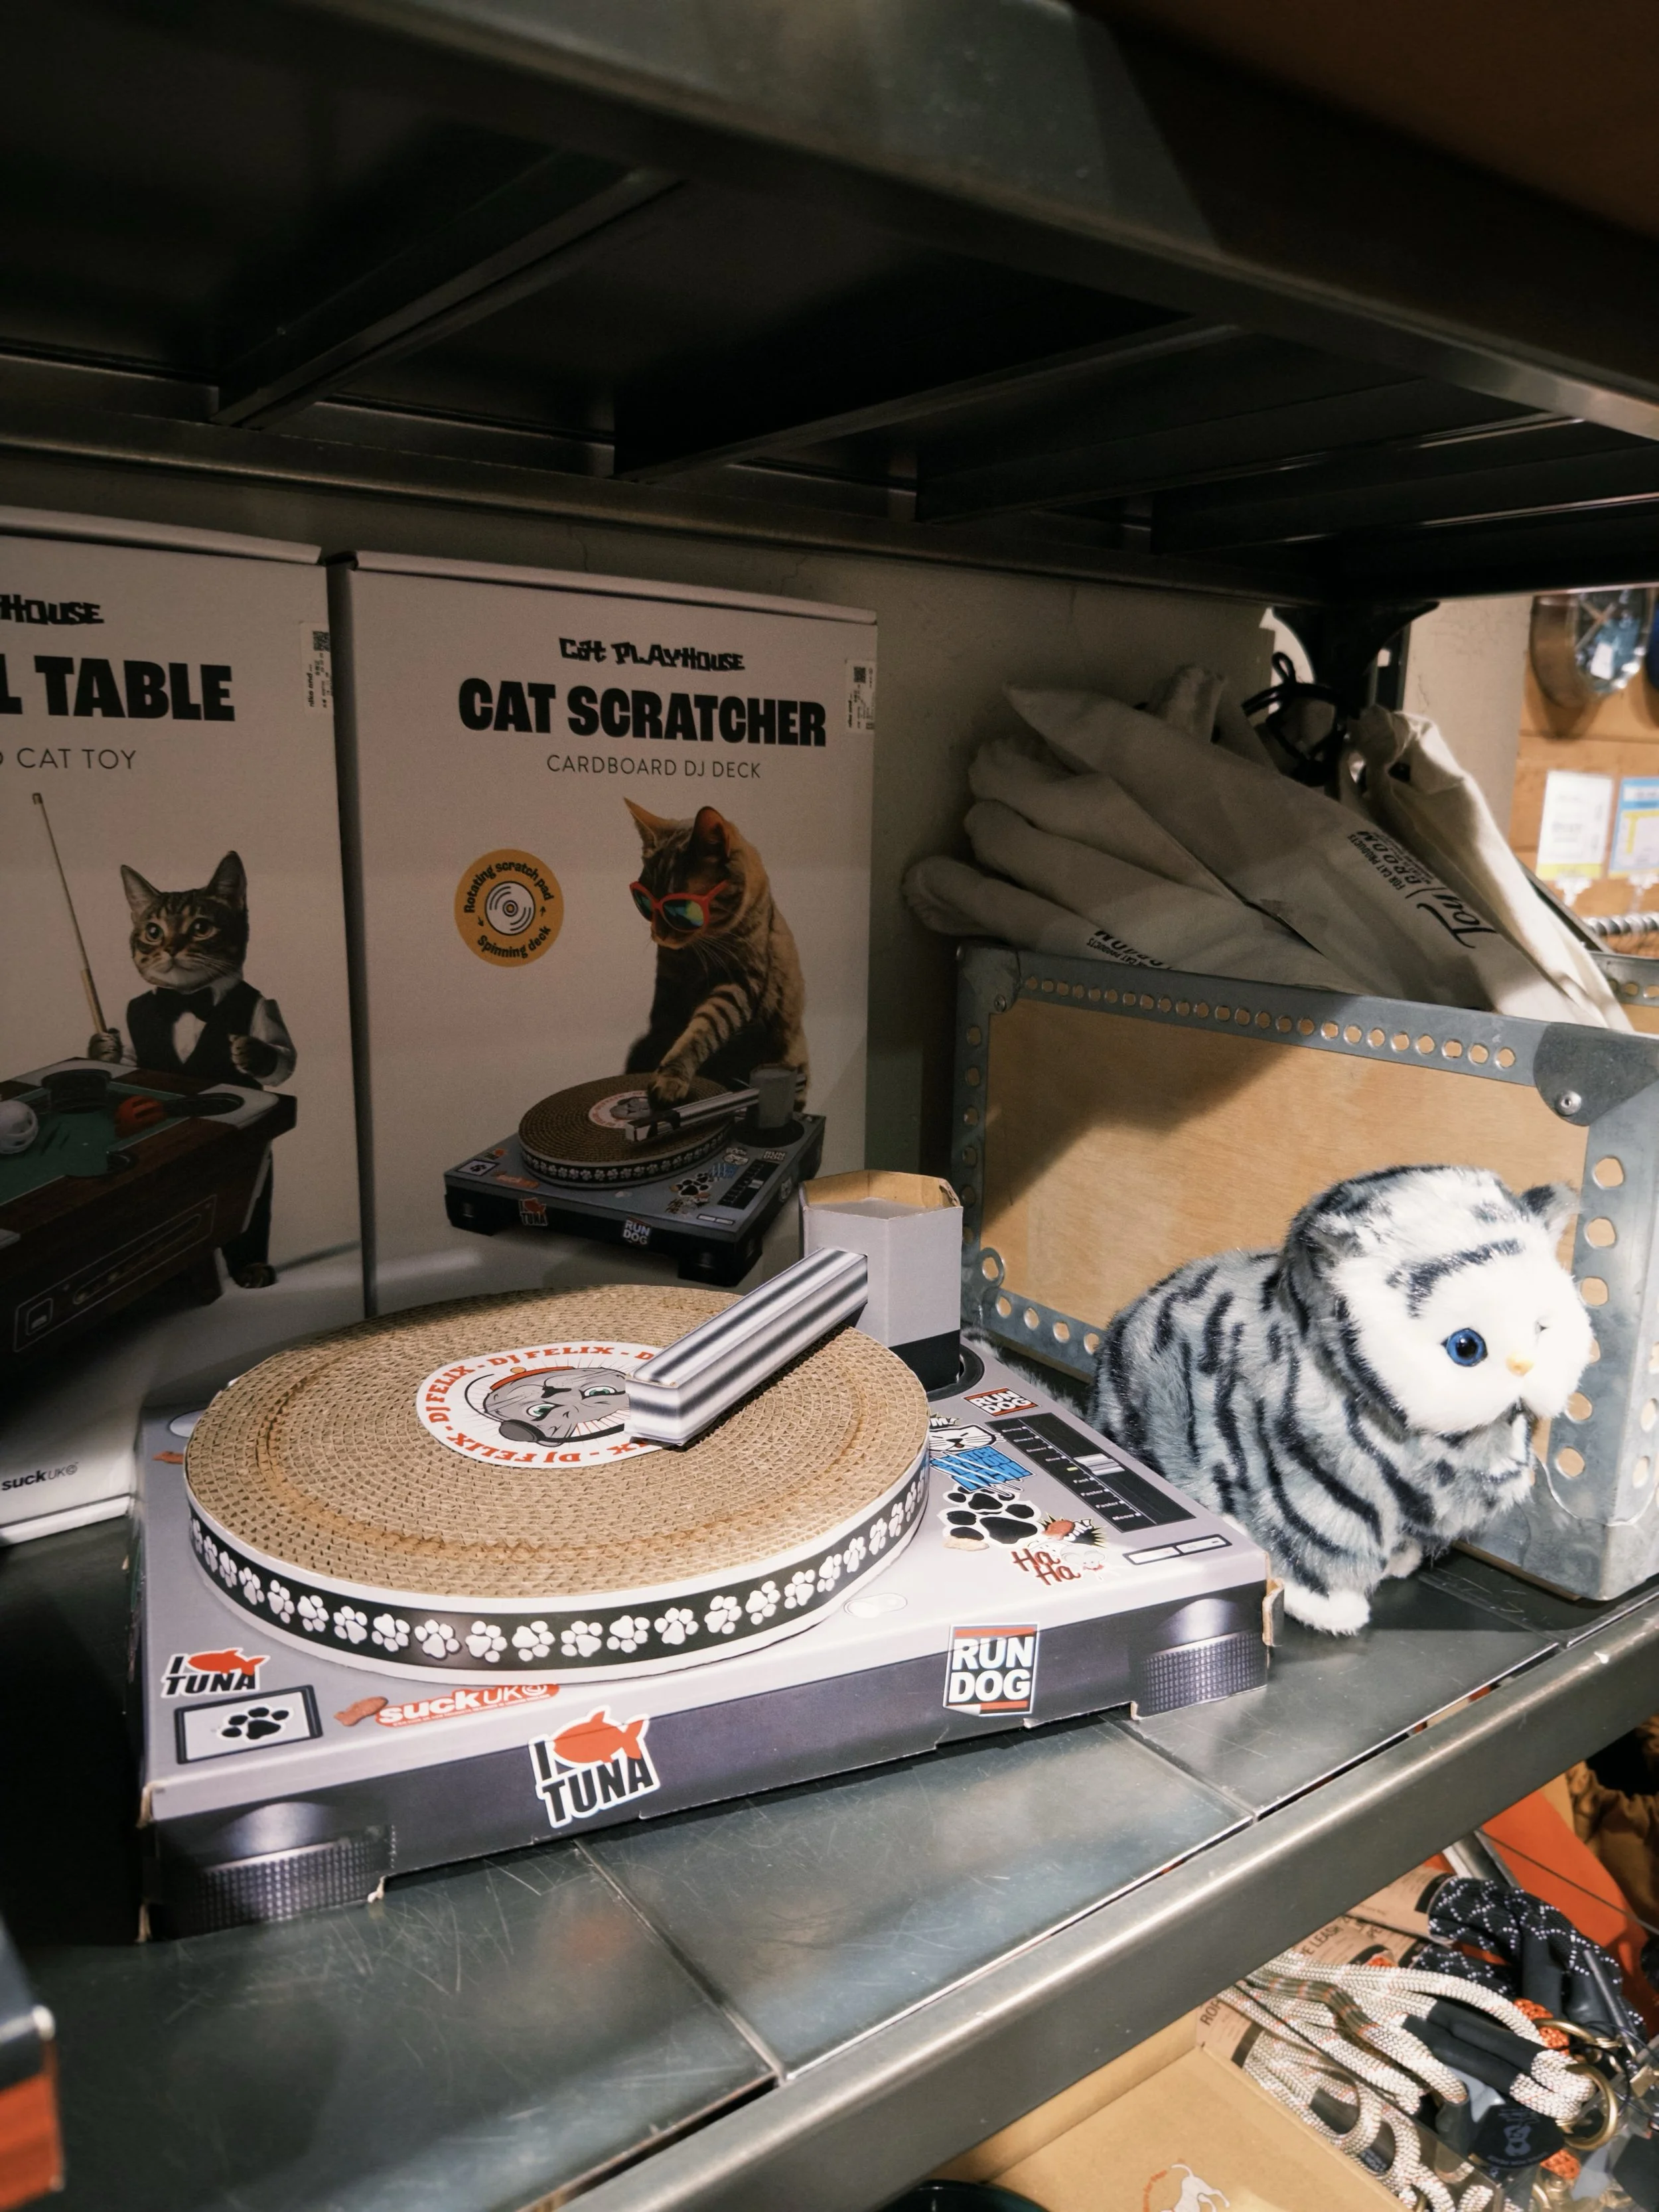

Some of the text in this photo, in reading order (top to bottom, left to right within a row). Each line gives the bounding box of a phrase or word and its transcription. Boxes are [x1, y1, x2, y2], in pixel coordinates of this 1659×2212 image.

[611, 642, 745, 672] PLAYHOUSE
[34, 655, 236, 721] TABLE
[459, 678, 556, 733] CAT
[567, 686, 826, 747] SCRATCHER
[17, 747, 71, 769] CAT
[82, 749, 136, 770] TOY
[547, 754, 761, 779] CARDBOARD DJ DECK
[1347, 834, 1378, 866] PRODUCTS
[1376, 864, 1393, 878] CAT
[463, 861, 554, 913] Rotating scratch pad
[1416, 893, 1498, 948] Toy
[477, 926, 551, 959] Spinning deck
[622, 1229, 648, 1245] DOG
[625, 1219, 650, 1236] RUN
[486, 1346, 615, 1368] DJ FELIX
[425, 1365, 475, 1424] DJ FELIX
[970, 1389, 1017, 1408] RUN
[981, 1398, 1032, 1414] DOG
[446, 1432, 581, 1463] DJ FELIX
[1011, 1548, 1061, 1572] Ha
[1035, 1564, 1082, 1586] Ha
[170, 1656, 184, 1674] I
[952, 1637, 1035, 1671] RUN
[166, 1672, 255, 1696] TUNA
[948, 1669, 1031, 1703] DOG
[534, 1739, 552, 1781] I
[541, 1755, 654, 1822] TUNA
